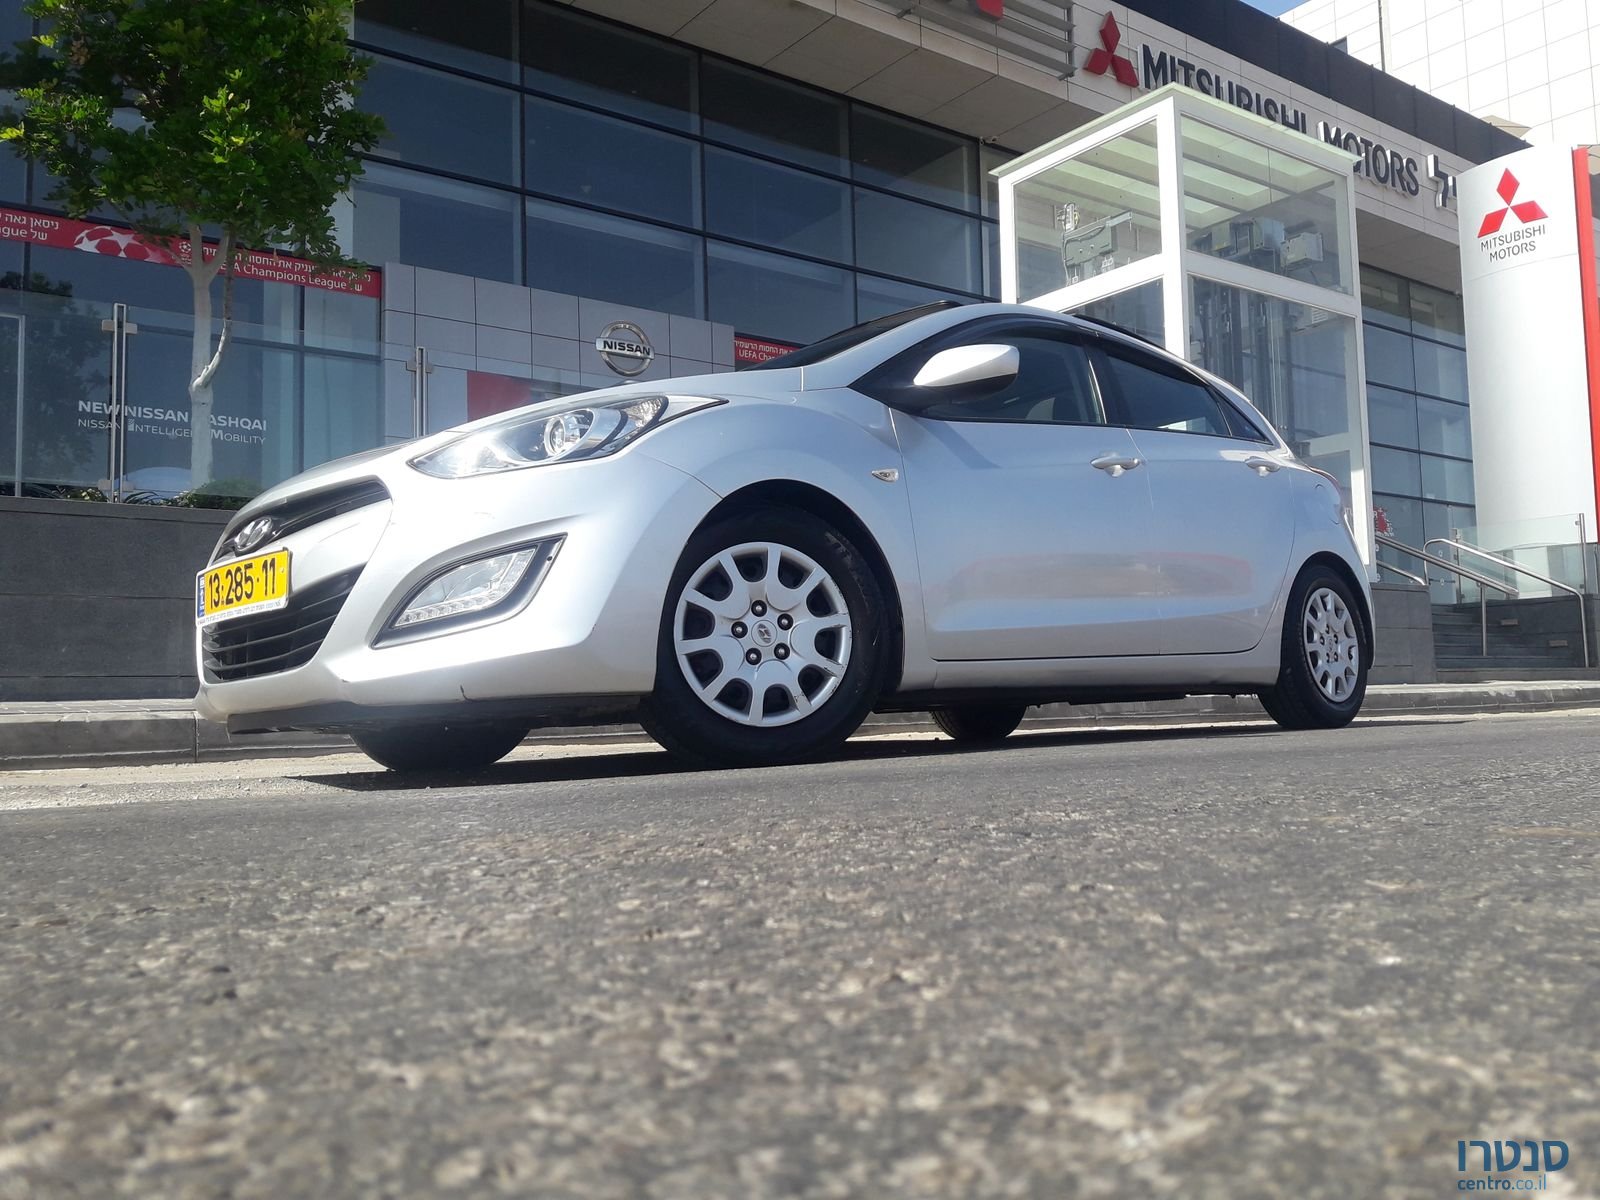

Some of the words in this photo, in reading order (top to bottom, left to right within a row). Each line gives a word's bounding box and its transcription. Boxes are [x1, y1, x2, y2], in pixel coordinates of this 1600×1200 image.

[5, 213, 27, 225] גאה
[30, 216, 60, 230] ניסאן
[30, 228, 48, 241] של
[1480, 224, 1546, 252] MITSUBISHI
[1489, 240, 1537, 263] MOTORS
[243, 263, 306, 283] Champions
[308, 275, 347, 290] League
[603, 340, 651, 356] NISSAN
[738, 349, 758, 360] UEFA
[78, 400, 120, 416] NEW
[124, 405, 189, 423] NISSAN
[78, 418, 121, 430] NISSAN
